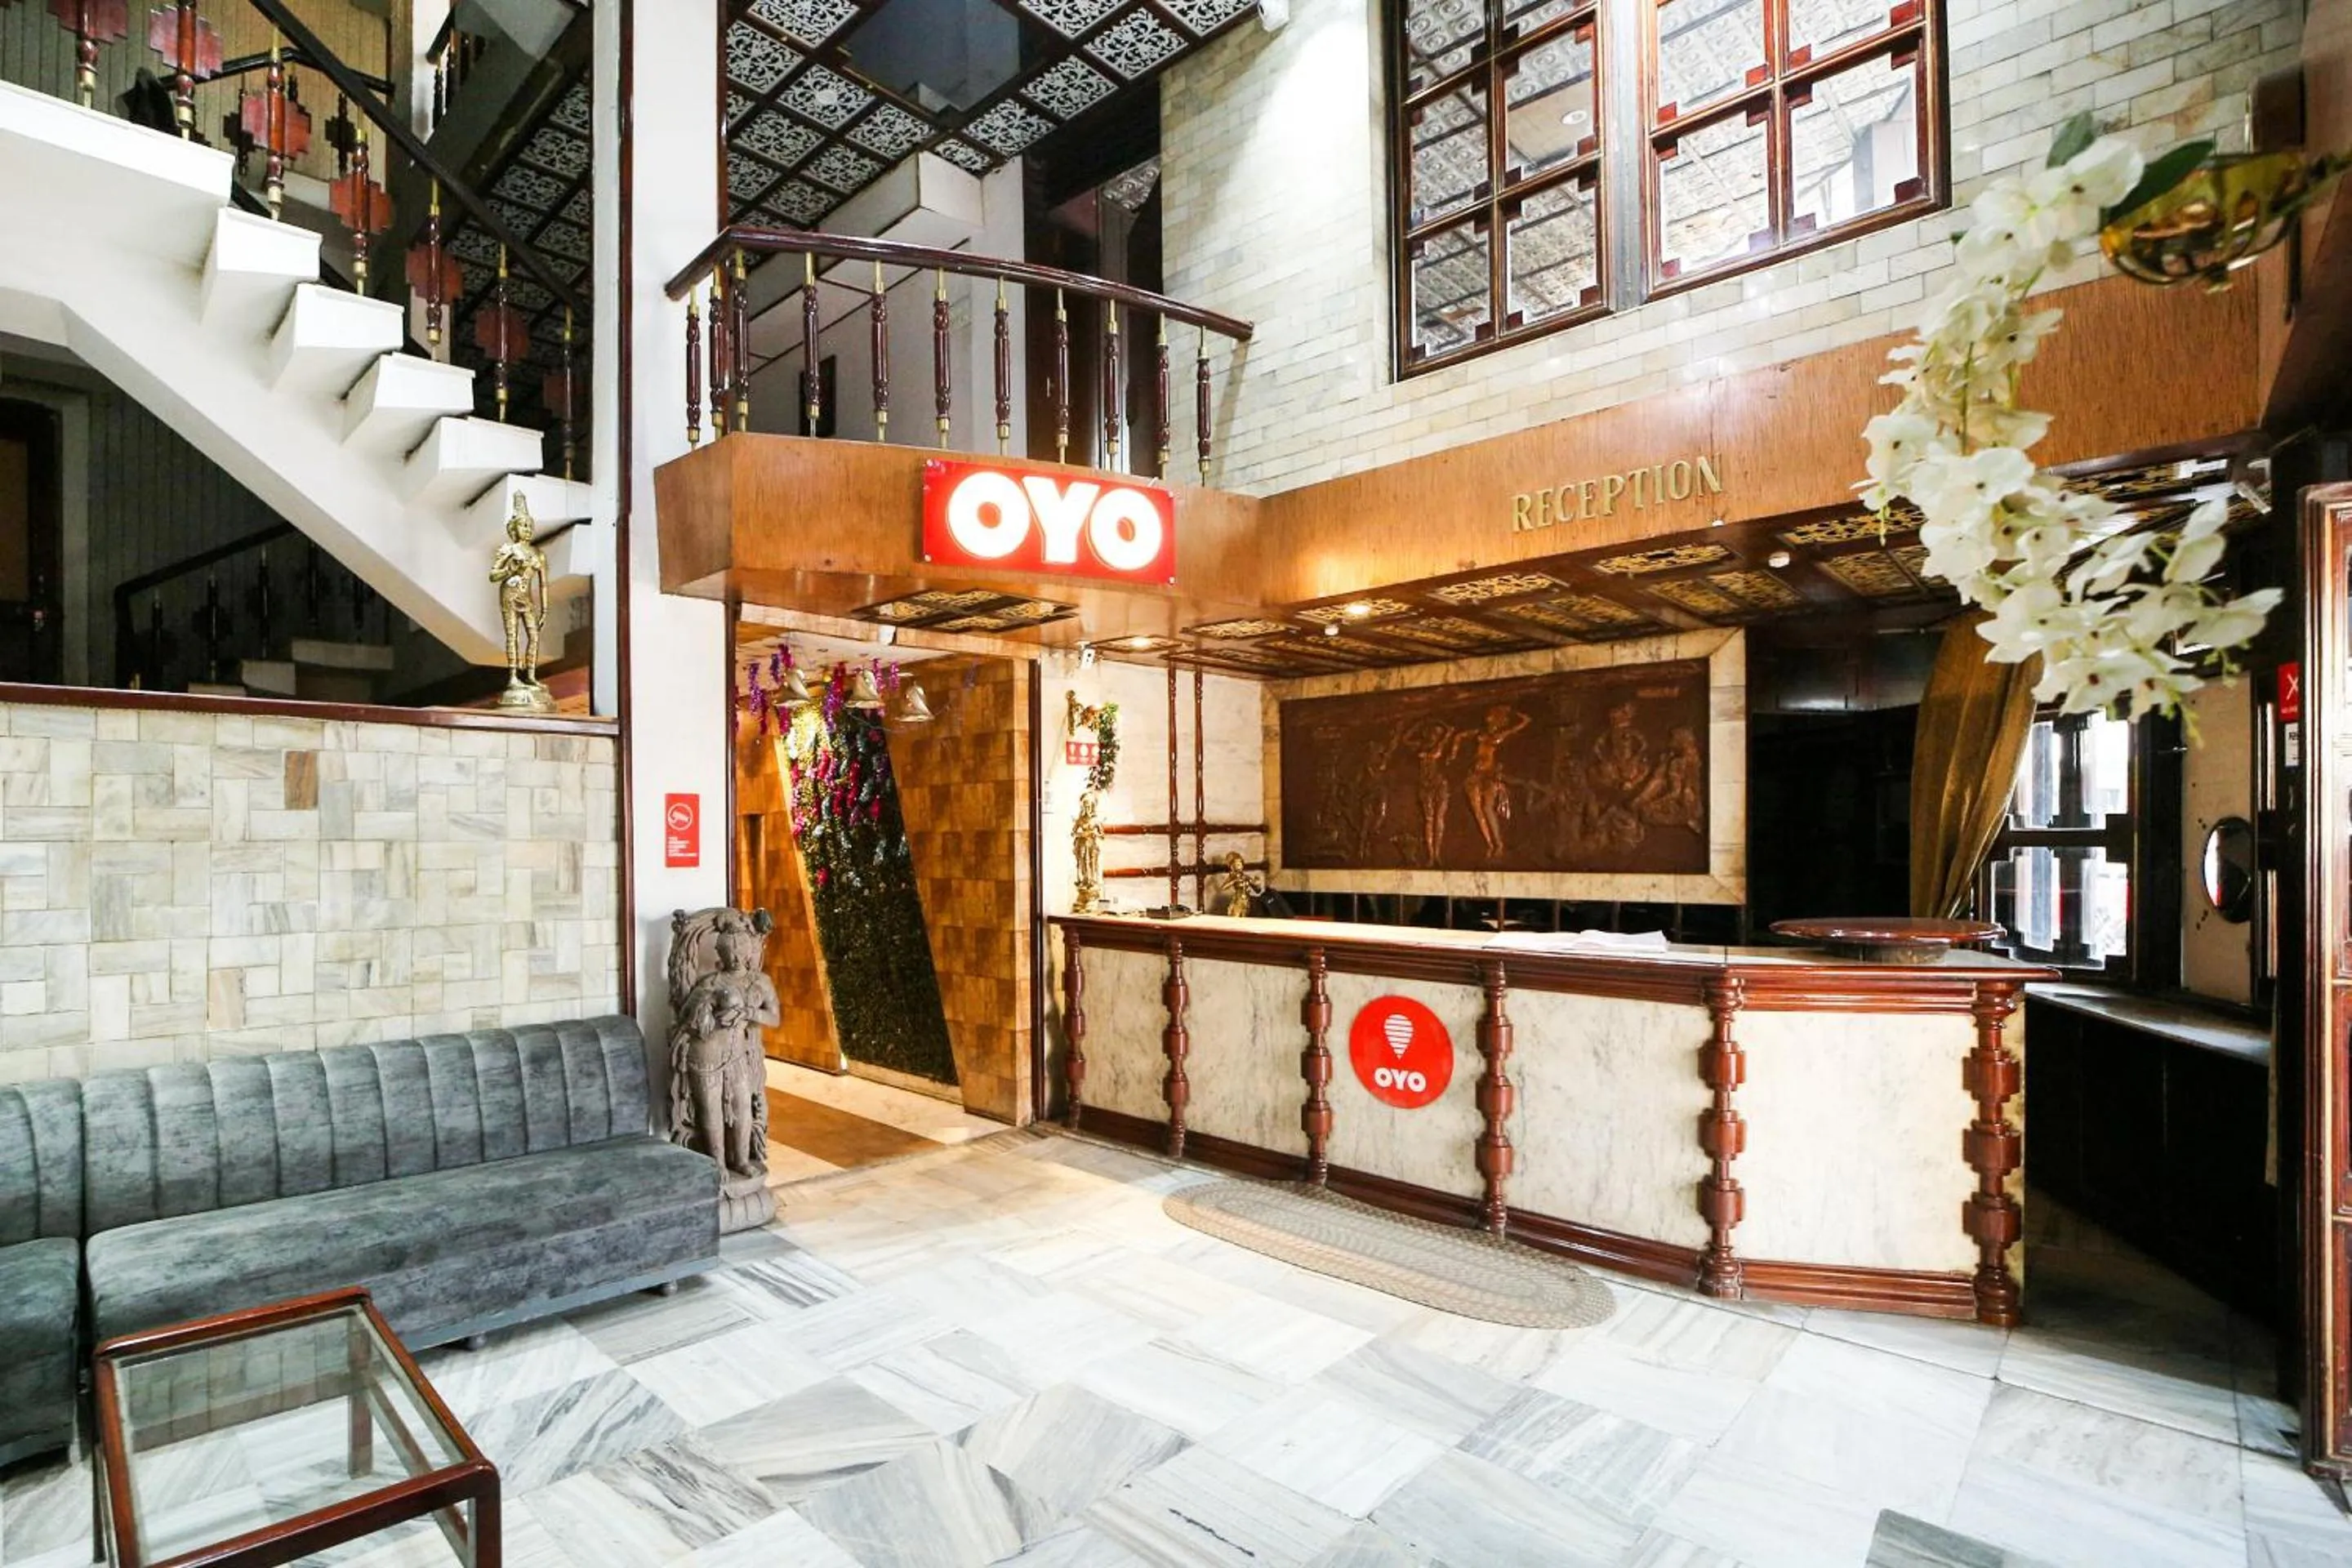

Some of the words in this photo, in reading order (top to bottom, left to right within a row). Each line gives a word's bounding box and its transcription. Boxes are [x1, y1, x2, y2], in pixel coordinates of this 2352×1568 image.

[947, 471, 1162, 570] OYO
[1512, 452, 1723, 532] RECEPTION
[1374, 1067, 1427, 1093] OYO
